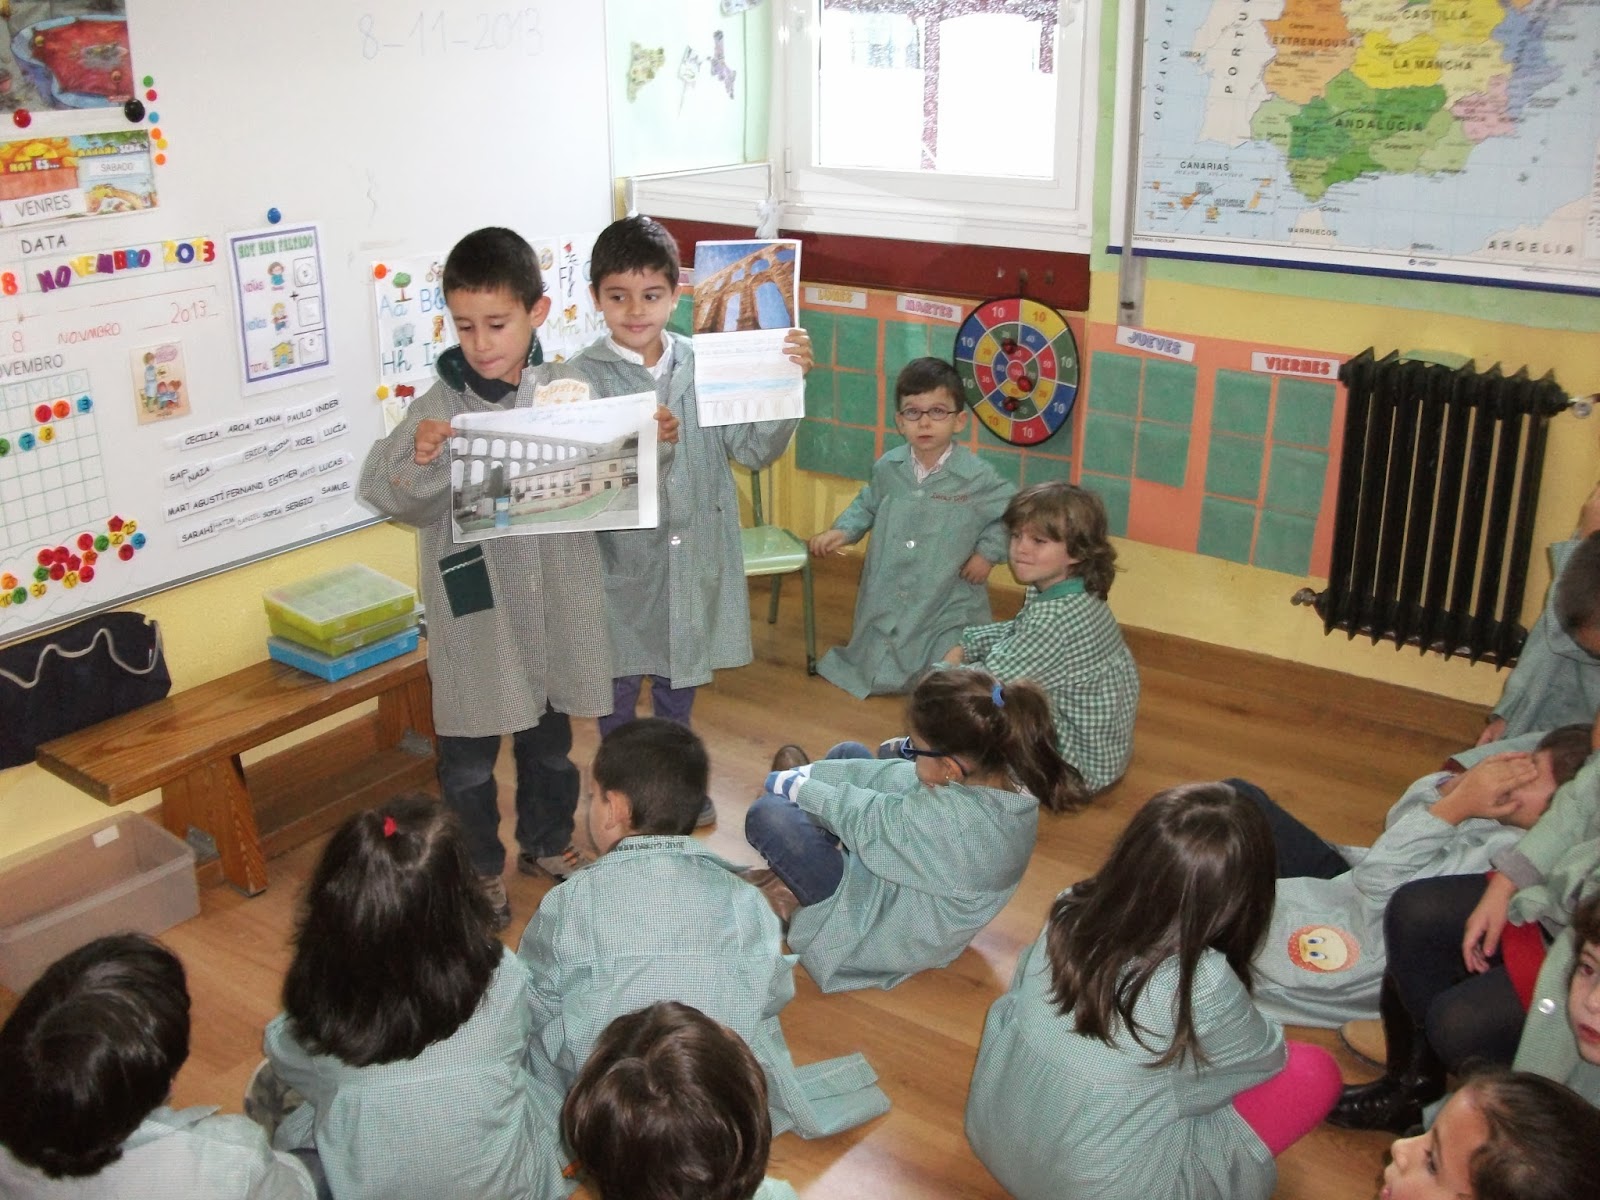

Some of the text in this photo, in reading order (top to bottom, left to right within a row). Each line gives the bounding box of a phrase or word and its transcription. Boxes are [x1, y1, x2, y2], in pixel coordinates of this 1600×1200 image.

[1272, 36, 1354, 48] EXTREMADURA
[1393, 59, 1471, 70] LA MANCHA
[1180, 161, 1230, 171] CANARIAS
[15, 194, 71, 217] VENRES
[1288, 227, 1338, 236] MARRUECOS
[21, 234, 67, 254] DATA
[1488, 240, 1575, 255] ARGELIA
[1, 272, 18, 295] 8
[162, 237, 216, 263] 2013
[904, 299, 954, 319] MARTES
[991, 306, 1005, 318] 10
[1032, 311, 1047, 323] 10
[12, 331, 24, 353] 8
[170, 300, 207, 324] 2013
[961, 336, 975, 348] 10
[1127, 331, 1182, 355] JUEVES
[1061, 355, 1073, 368] 10
[1264, 356, 1331, 376] VIERNES
[962, 377, 974, 389] 10
[1053, 401, 1066, 414] 10
[185, 430, 220, 445] CECILIA
[228, 422, 250, 433] AROA
[254, 414, 281, 426] XIANA
[287, 408, 312, 423] PAULO
[987, 414, 999, 427] 10
[1022, 426, 1034, 439] 10
[187, 467, 211, 482] NAIA
[244, 445, 268, 460] ERICA
[295, 436, 315, 447] XOEL
[323, 422, 348, 437] LUCÍA
[268, 468, 298, 487] ESTHER
[318, 457, 344, 472] LUCAS
[285, 496, 314, 512] SERGIO
[321, 481, 350, 495] SAMUEL
